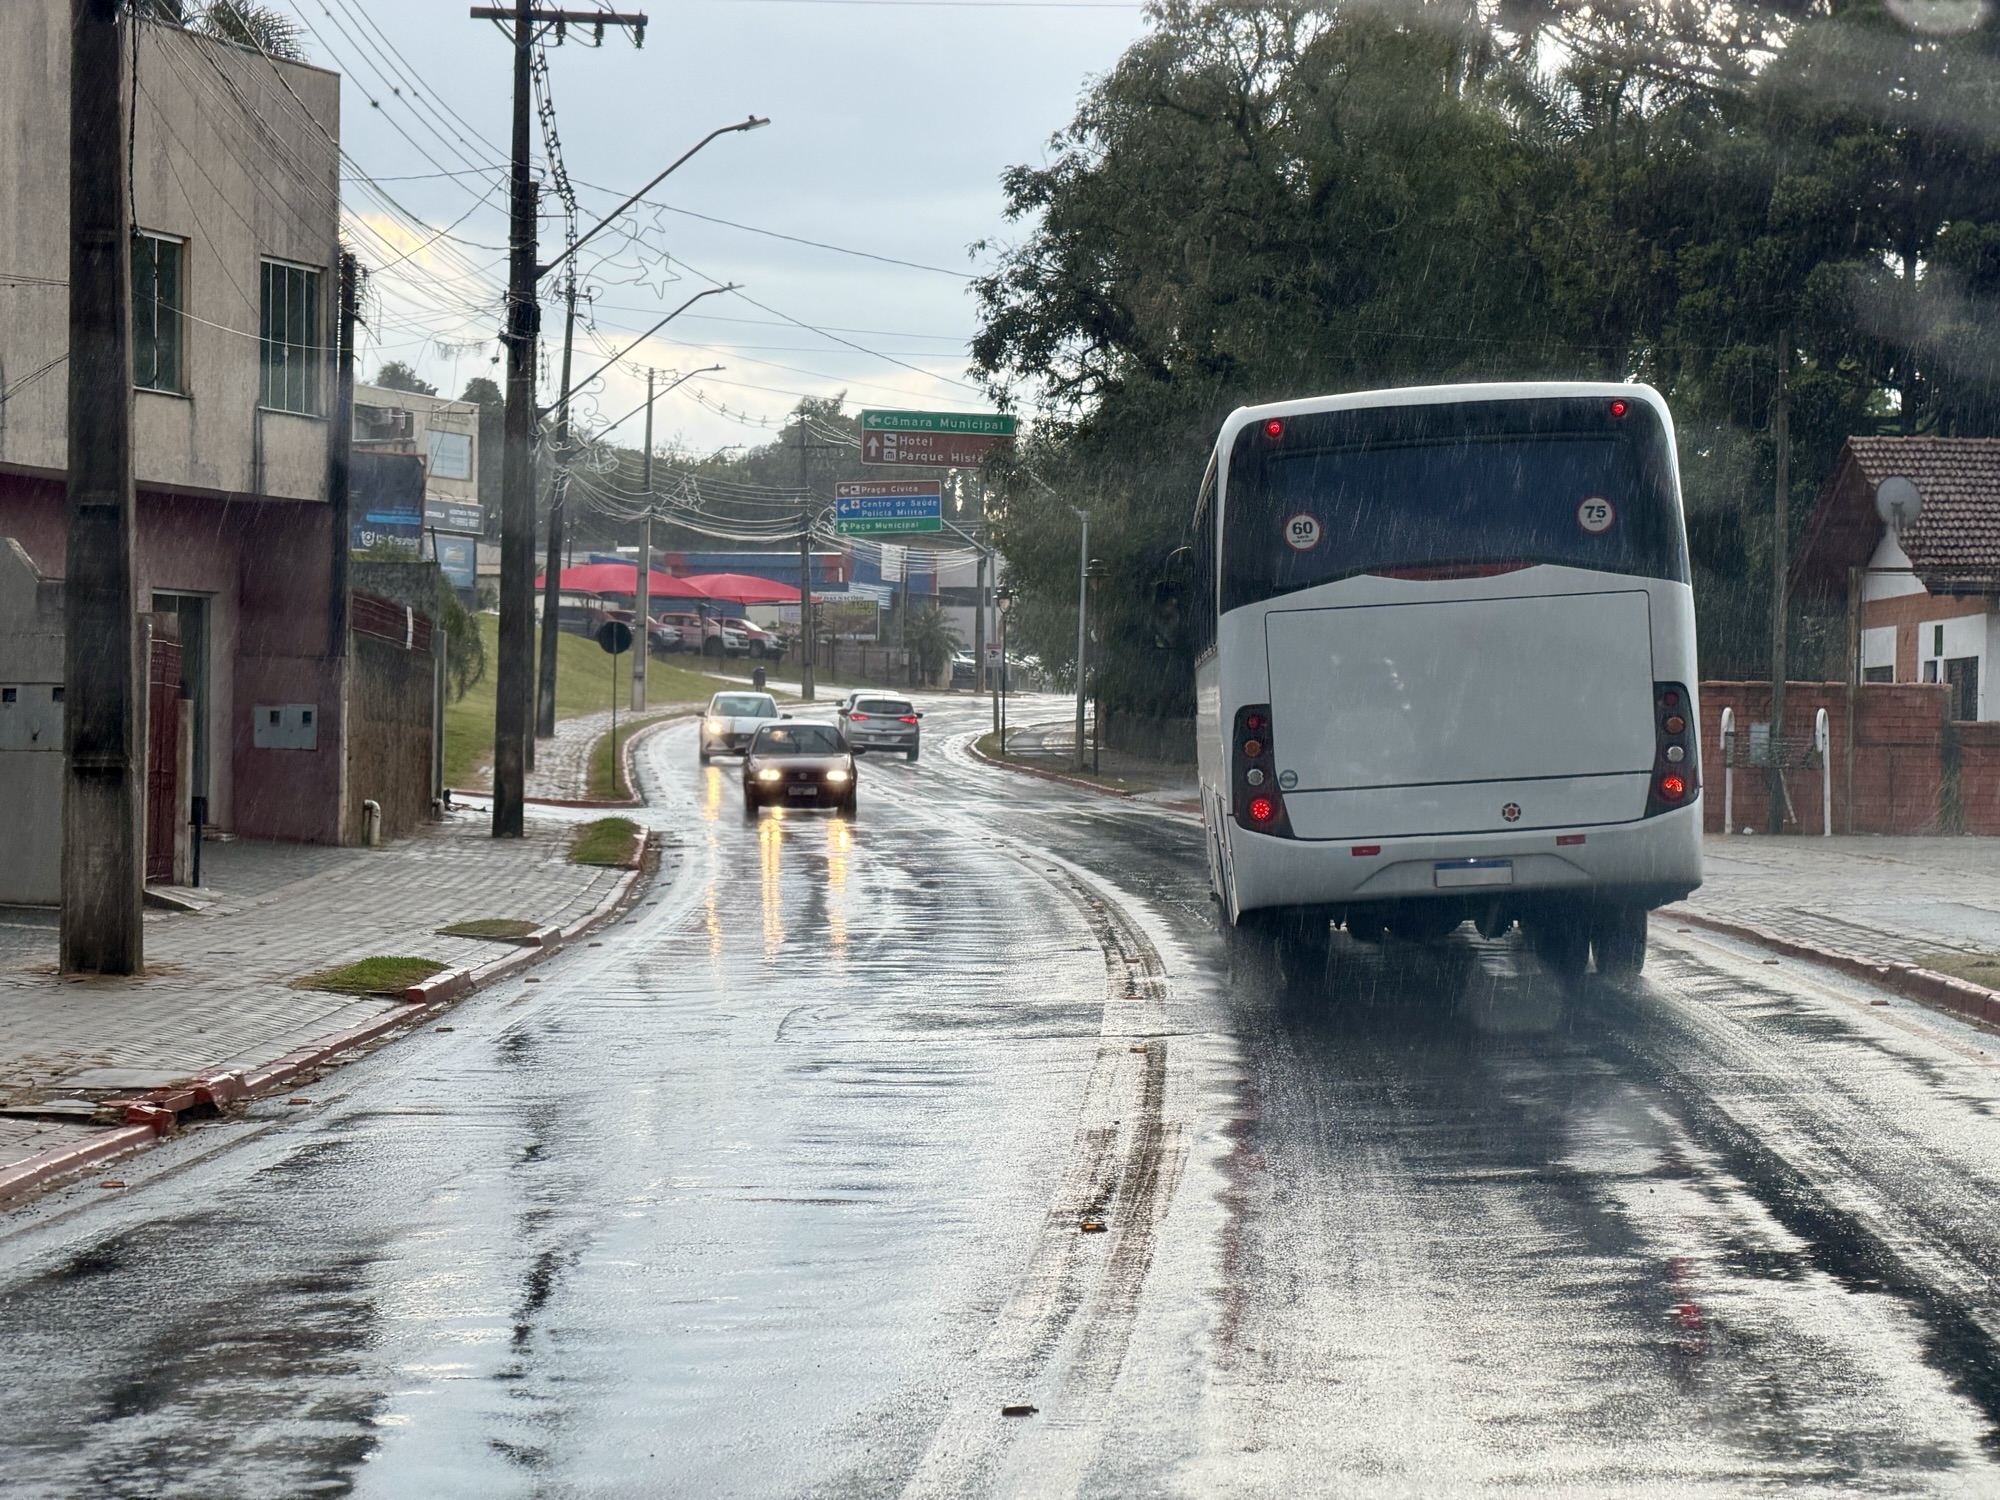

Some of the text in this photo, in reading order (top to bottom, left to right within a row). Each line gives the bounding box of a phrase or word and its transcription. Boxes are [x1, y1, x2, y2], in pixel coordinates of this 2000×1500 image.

[883, 416, 1004, 431] Câmara Municipal
[900, 436, 933, 447] Hotel
[899, 451, 985, 464] Parque Histó
[861, 486, 886, 494] Praça
[910, 499, 938, 507] Saúde
[1584, 505, 1607, 519] 75
[850, 521, 919, 530] Paço Municipal
[1292, 521, 1313, 535] 60
